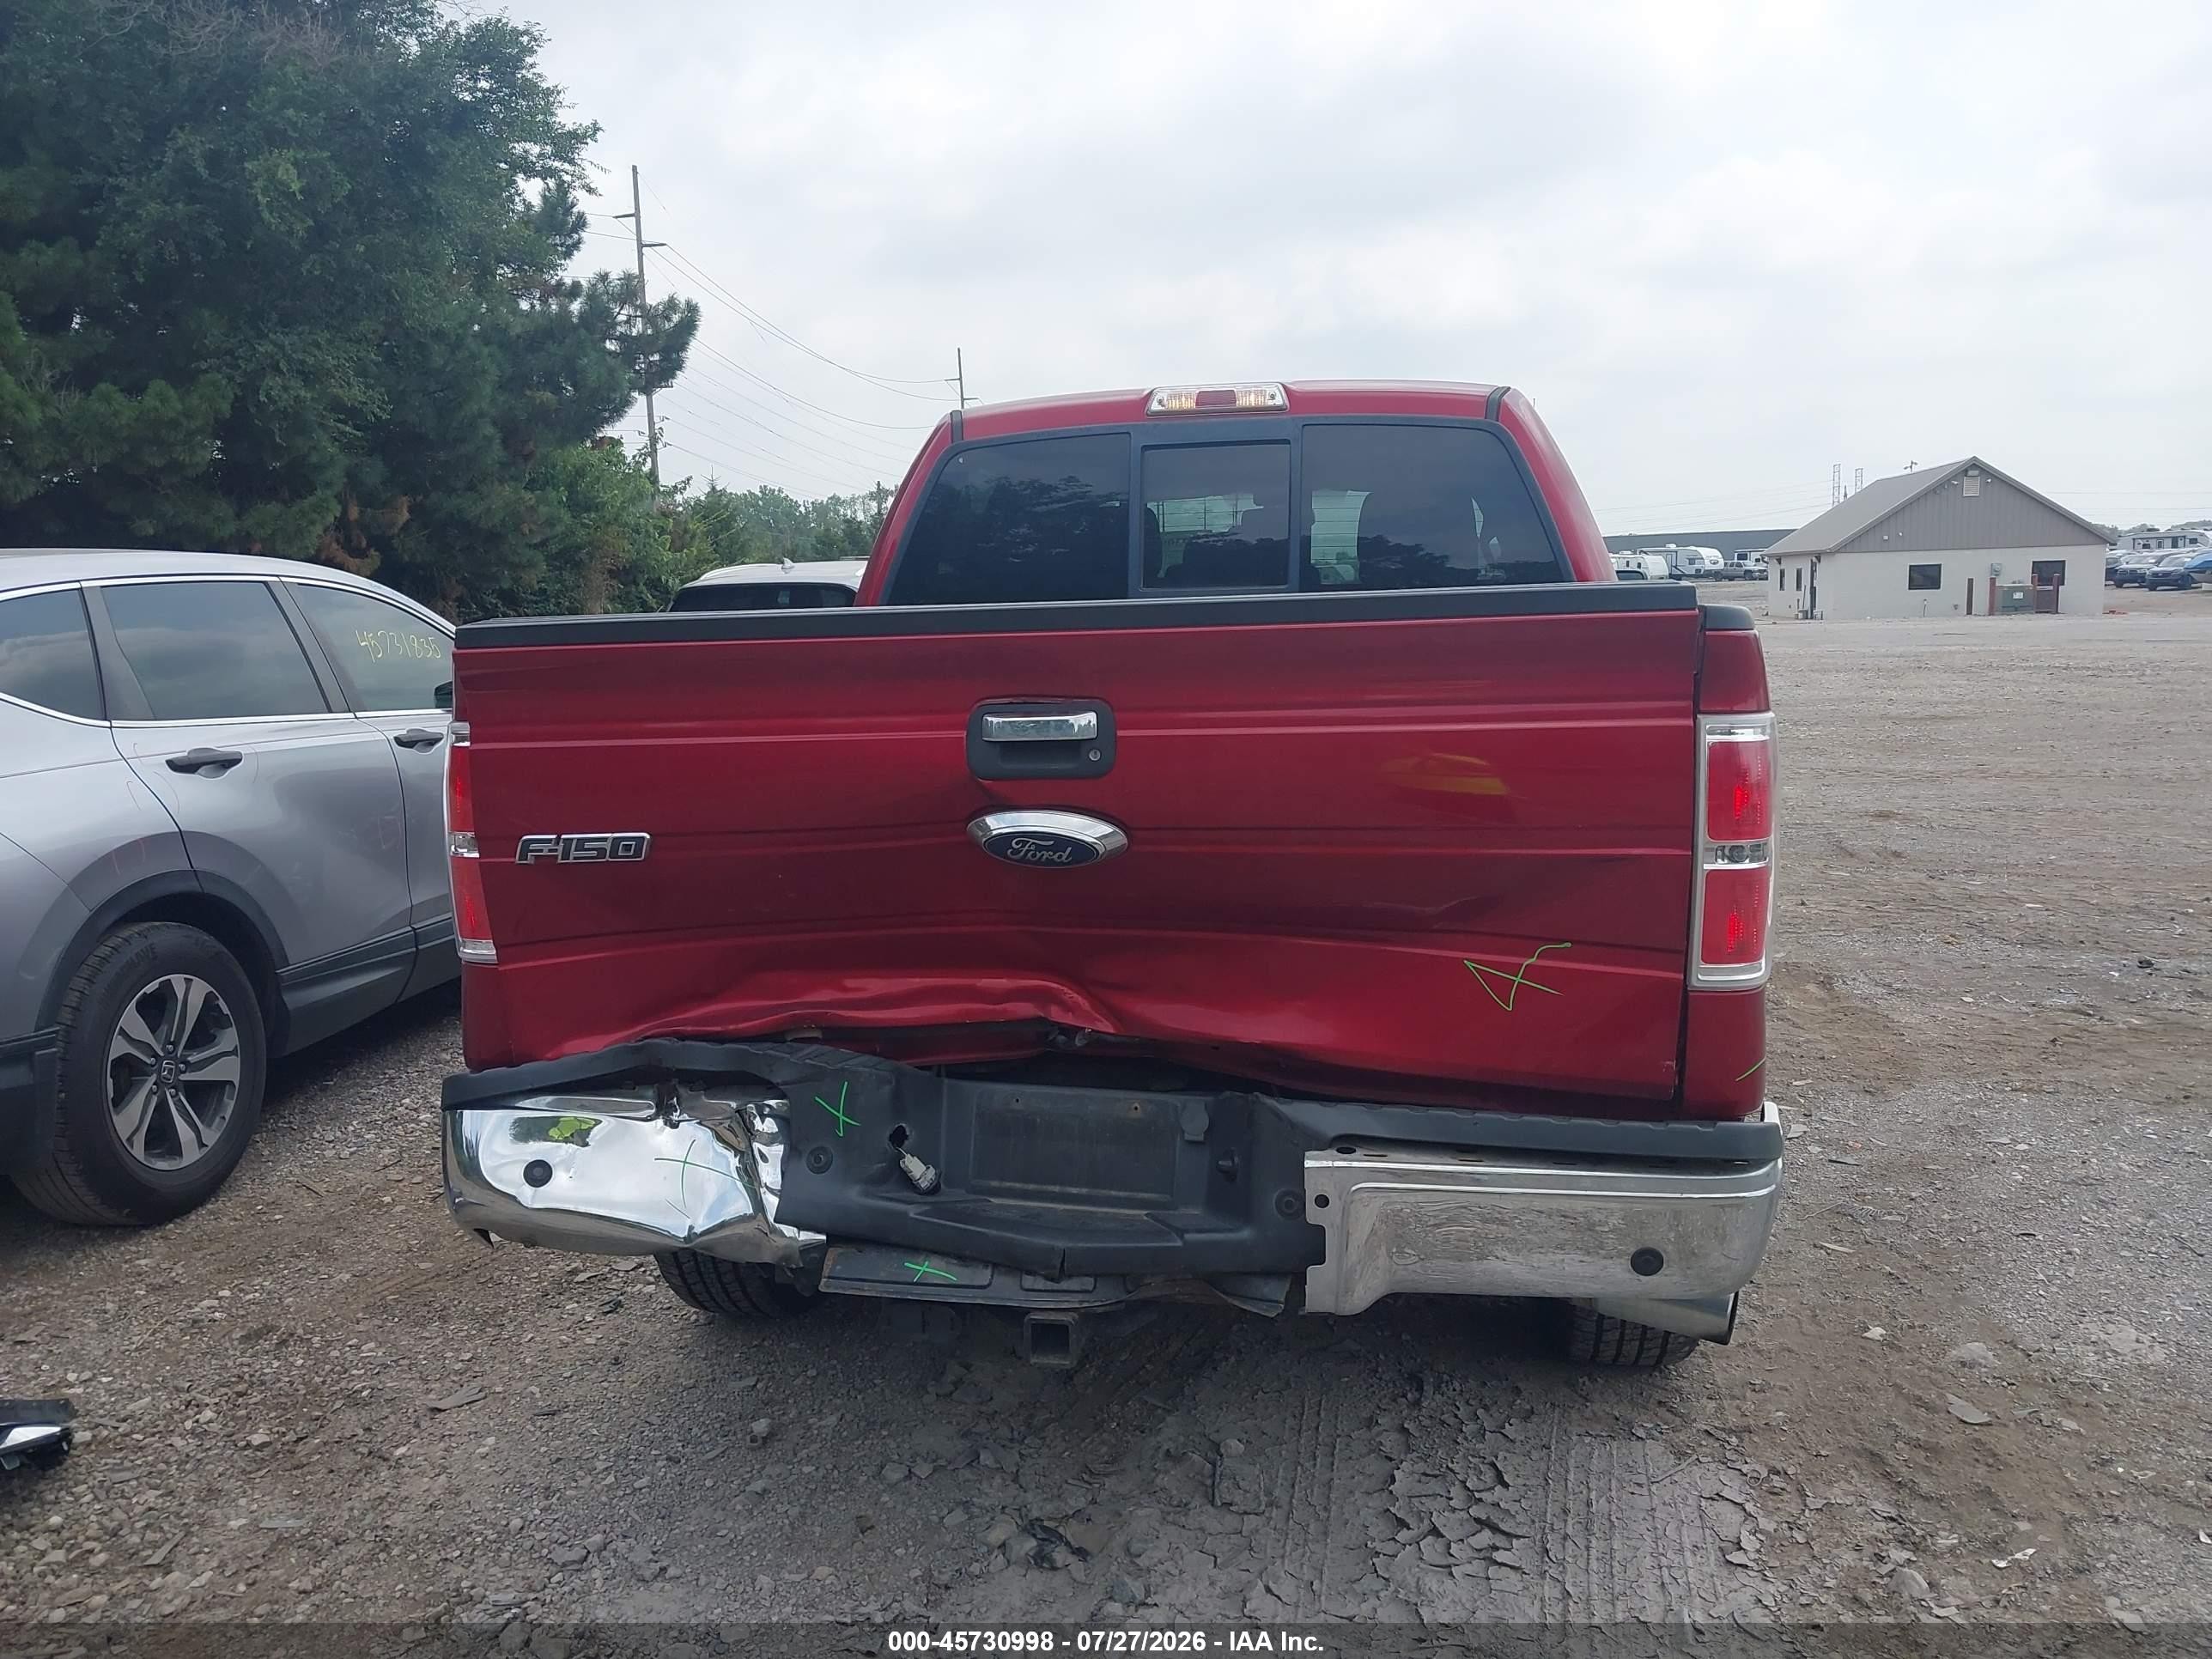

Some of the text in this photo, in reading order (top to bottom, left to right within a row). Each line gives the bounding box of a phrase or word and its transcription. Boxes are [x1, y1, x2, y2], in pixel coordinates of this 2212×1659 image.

[356, 629, 441, 663] 45731835
[516, 832, 651, 865] F-150
[1007, 837, 1073, 863] Ford
